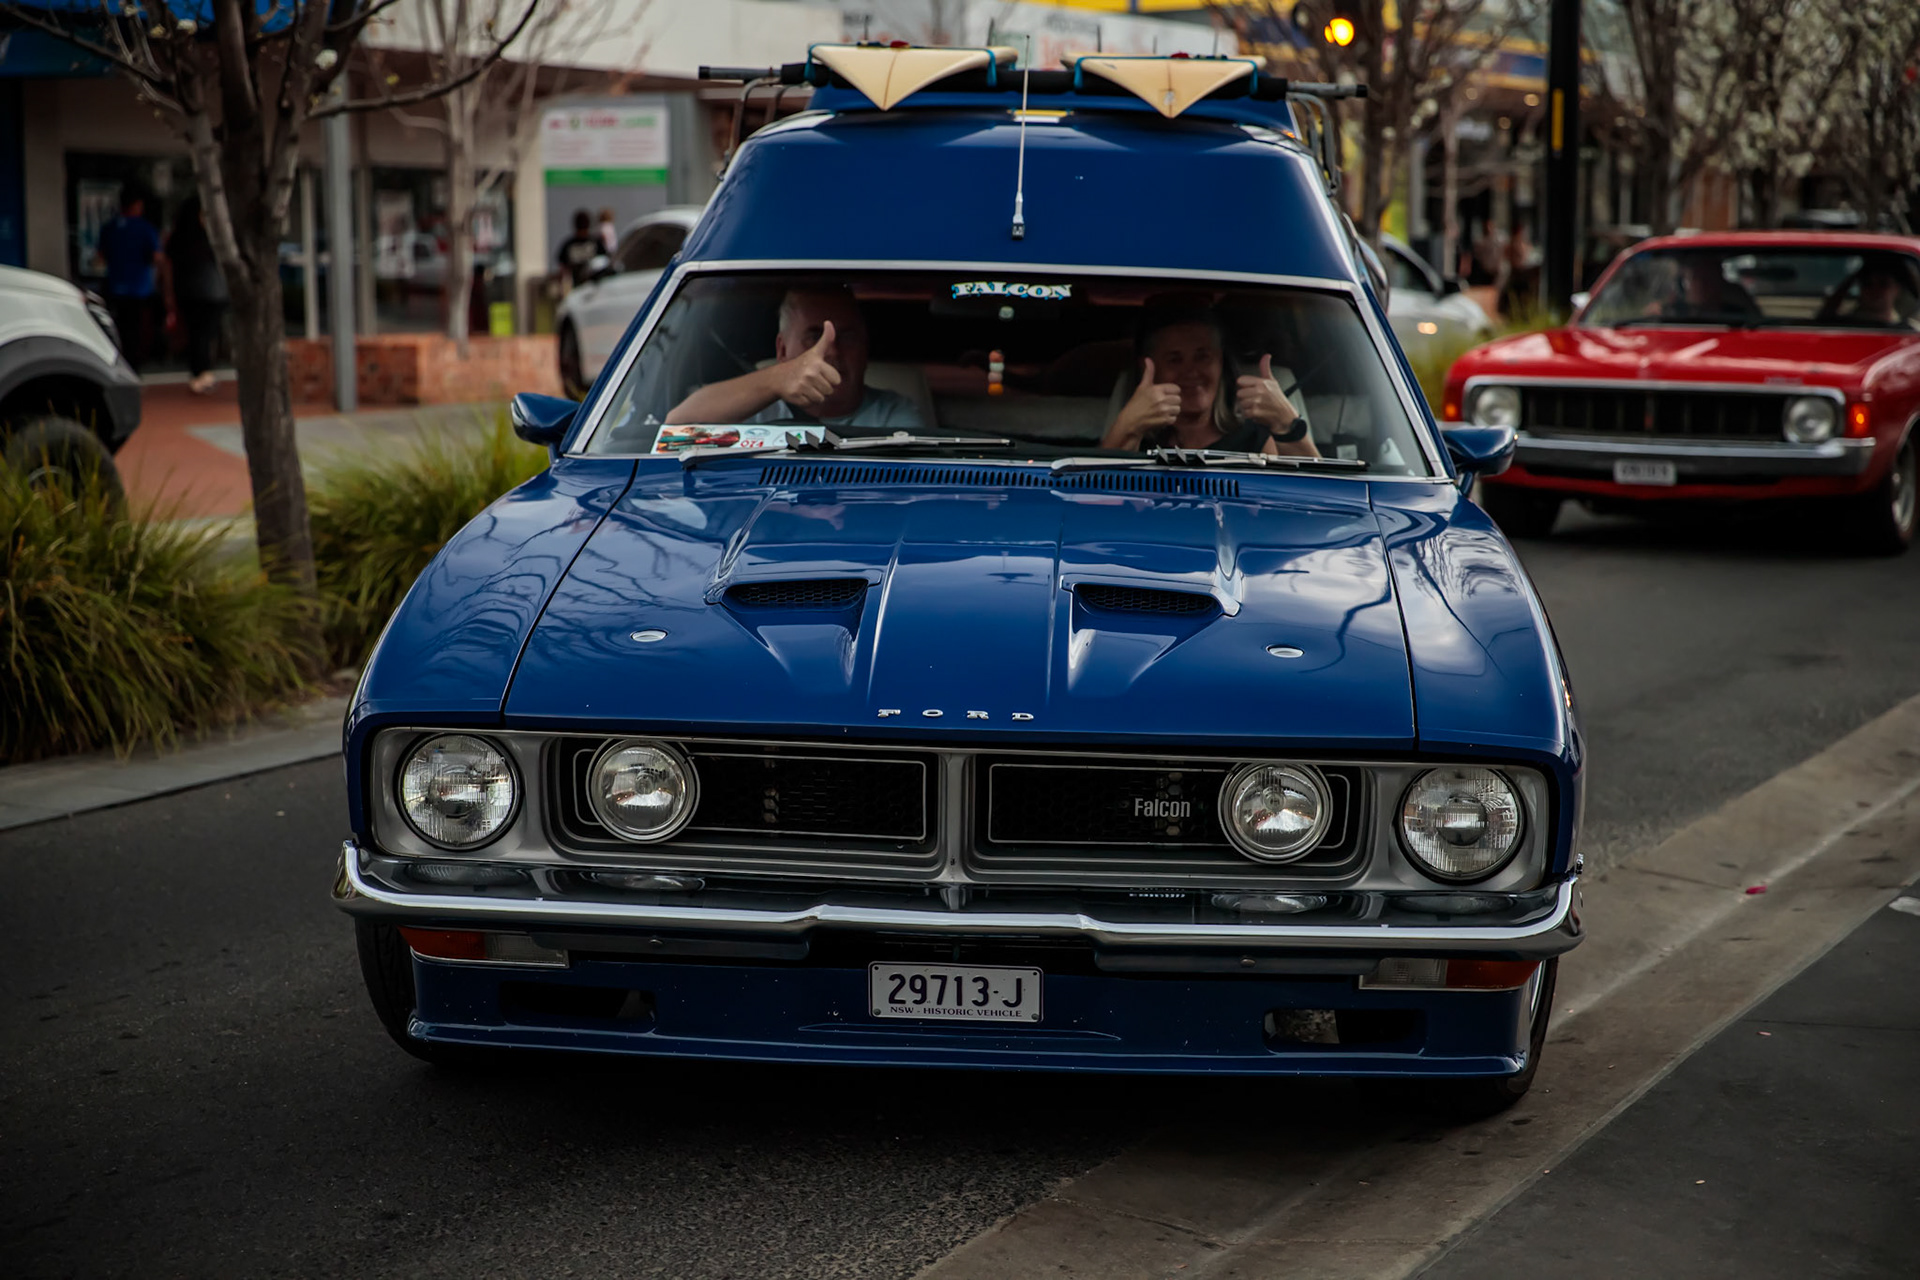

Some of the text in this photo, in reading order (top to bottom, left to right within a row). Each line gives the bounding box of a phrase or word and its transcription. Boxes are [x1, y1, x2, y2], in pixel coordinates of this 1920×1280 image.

[952, 281, 1072, 299] FALCON
[877, 708, 1034, 721] FORD
[1134, 797, 1191, 818] Falcon
[888, 973, 1022, 1008] 29713-J
[890, 1006, 914, 1015] NSW
[923, 1007, 974, 1016] HISTORIC
[977, 1009, 1022, 1017] VEHICLE
